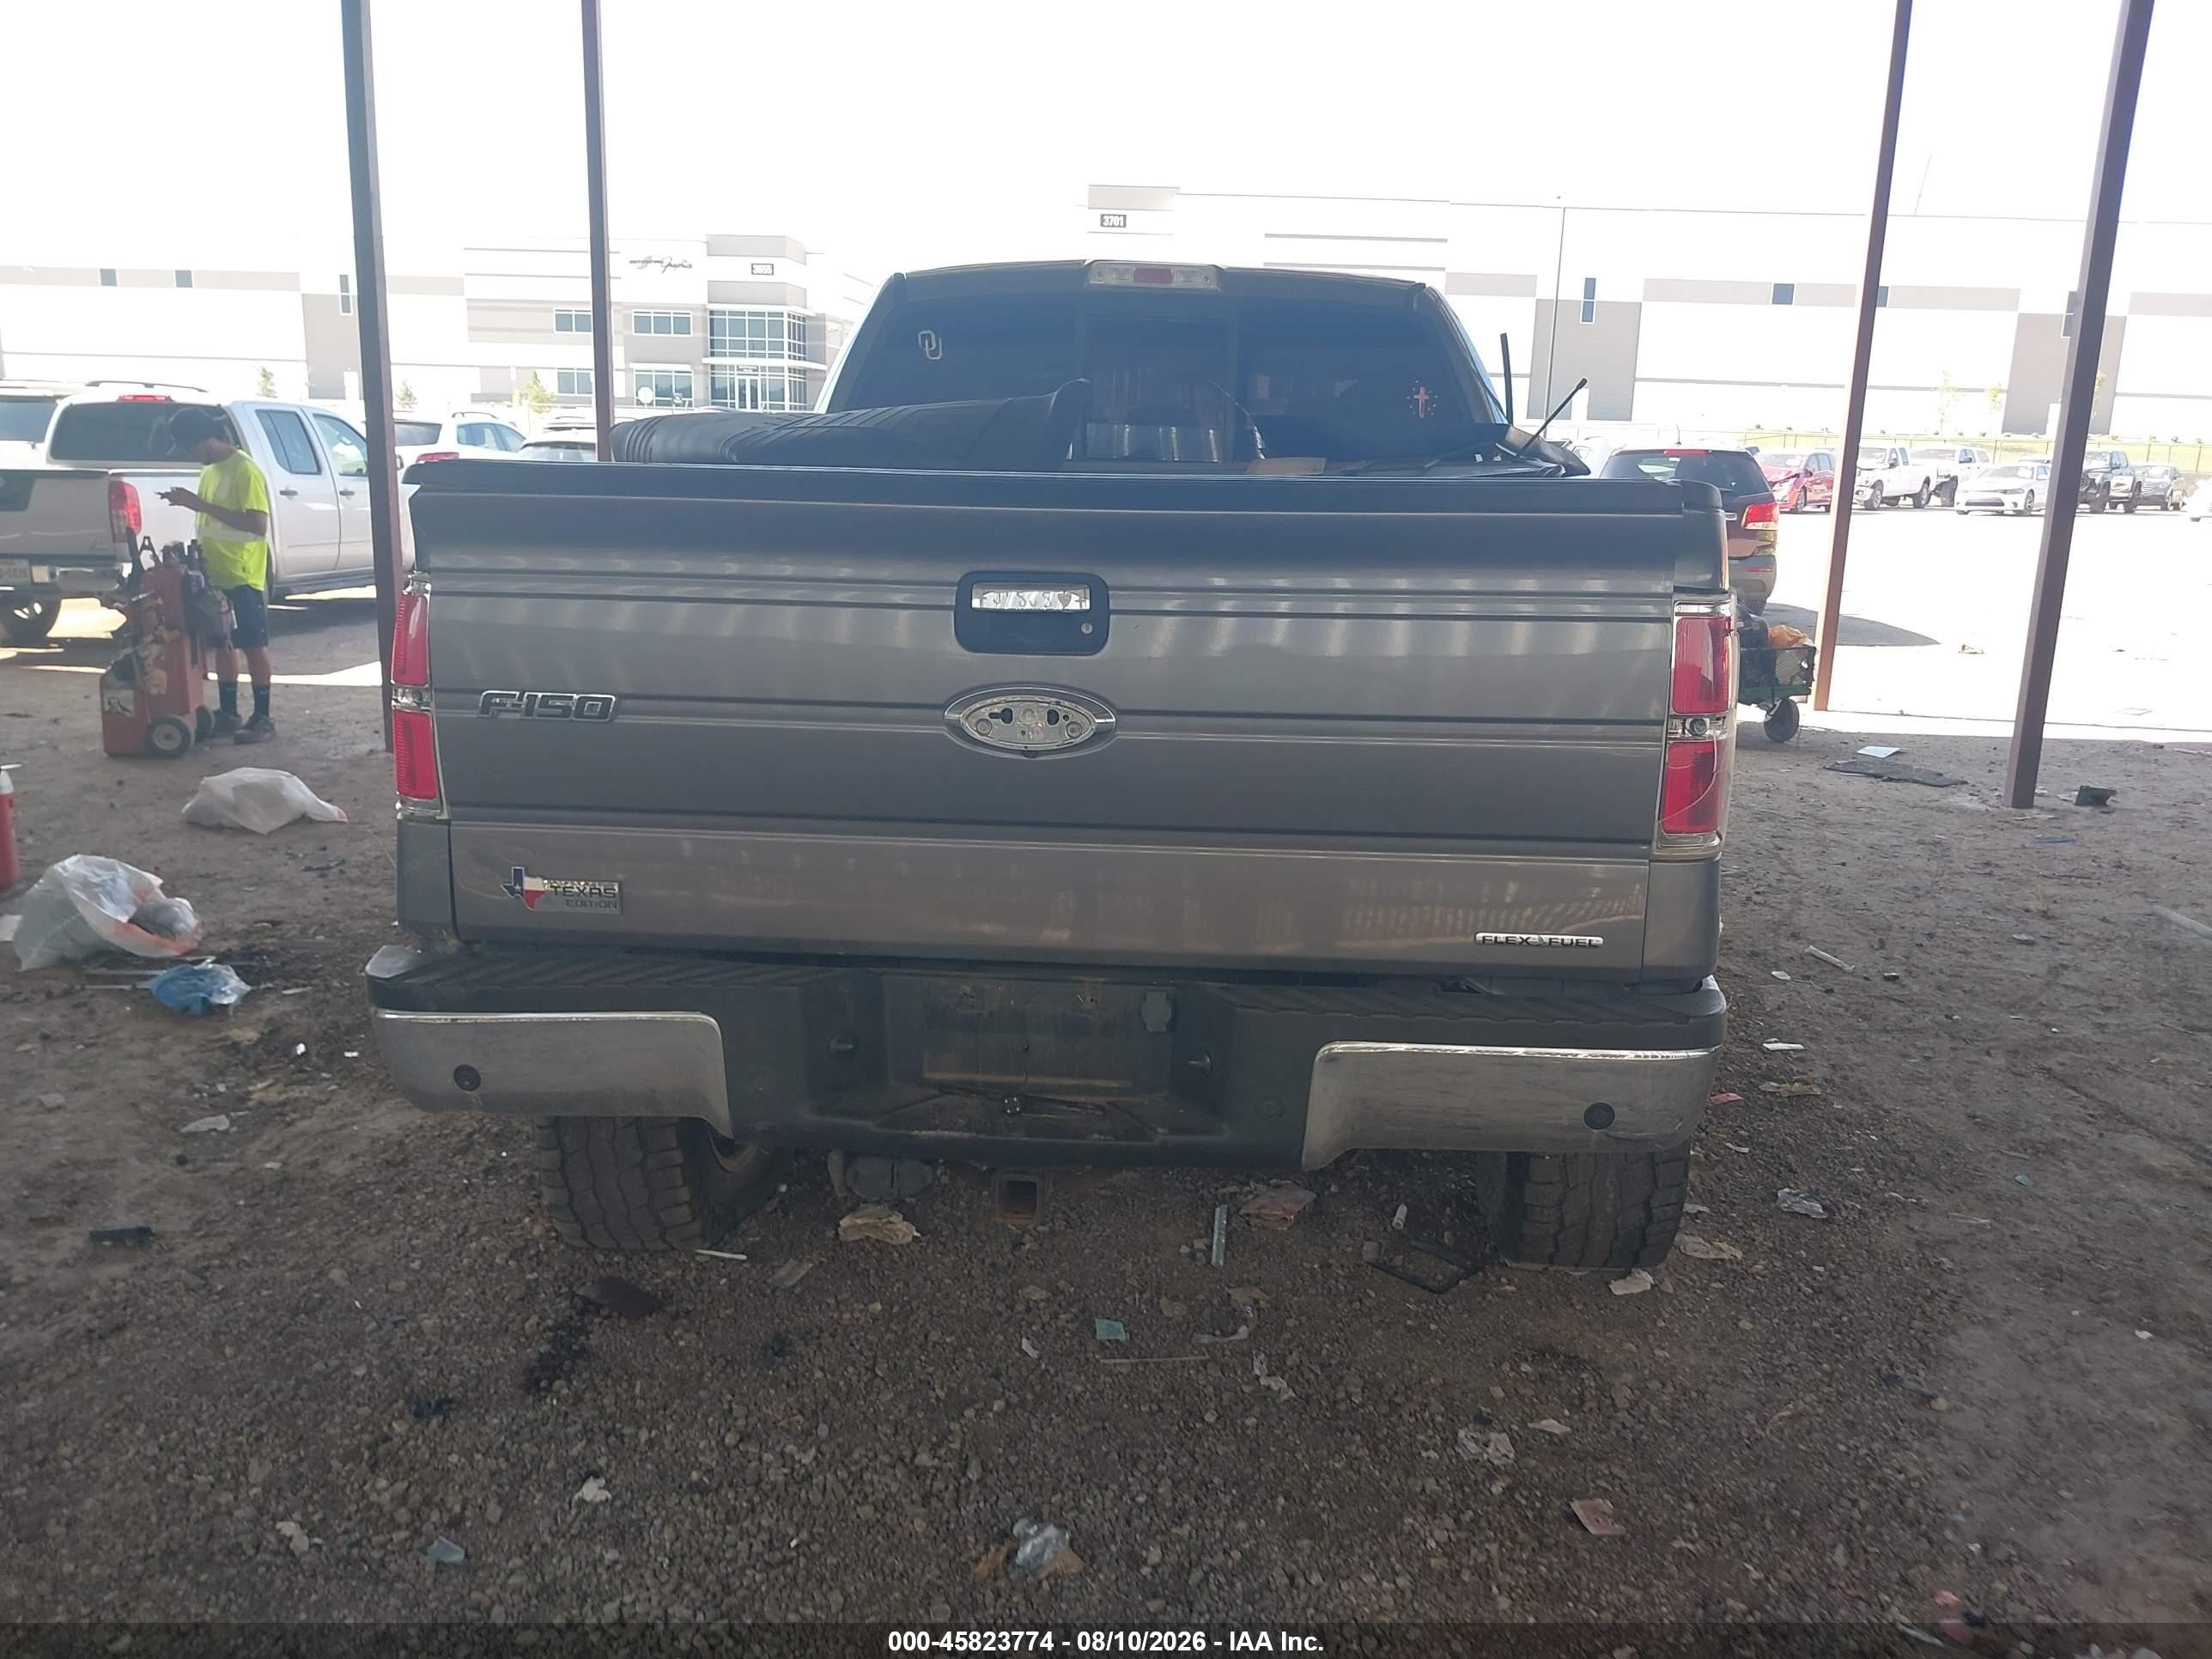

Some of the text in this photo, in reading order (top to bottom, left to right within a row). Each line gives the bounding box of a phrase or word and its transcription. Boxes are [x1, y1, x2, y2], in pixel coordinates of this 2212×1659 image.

[1102, 215, 1125, 227] 3701
[478, 690, 617, 722] F-150
[550, 884, 617, 899] TEXAS
[565, 899, 618, 910] EDITION
[1481, 934, 1601, 948] FLEX FUEL
